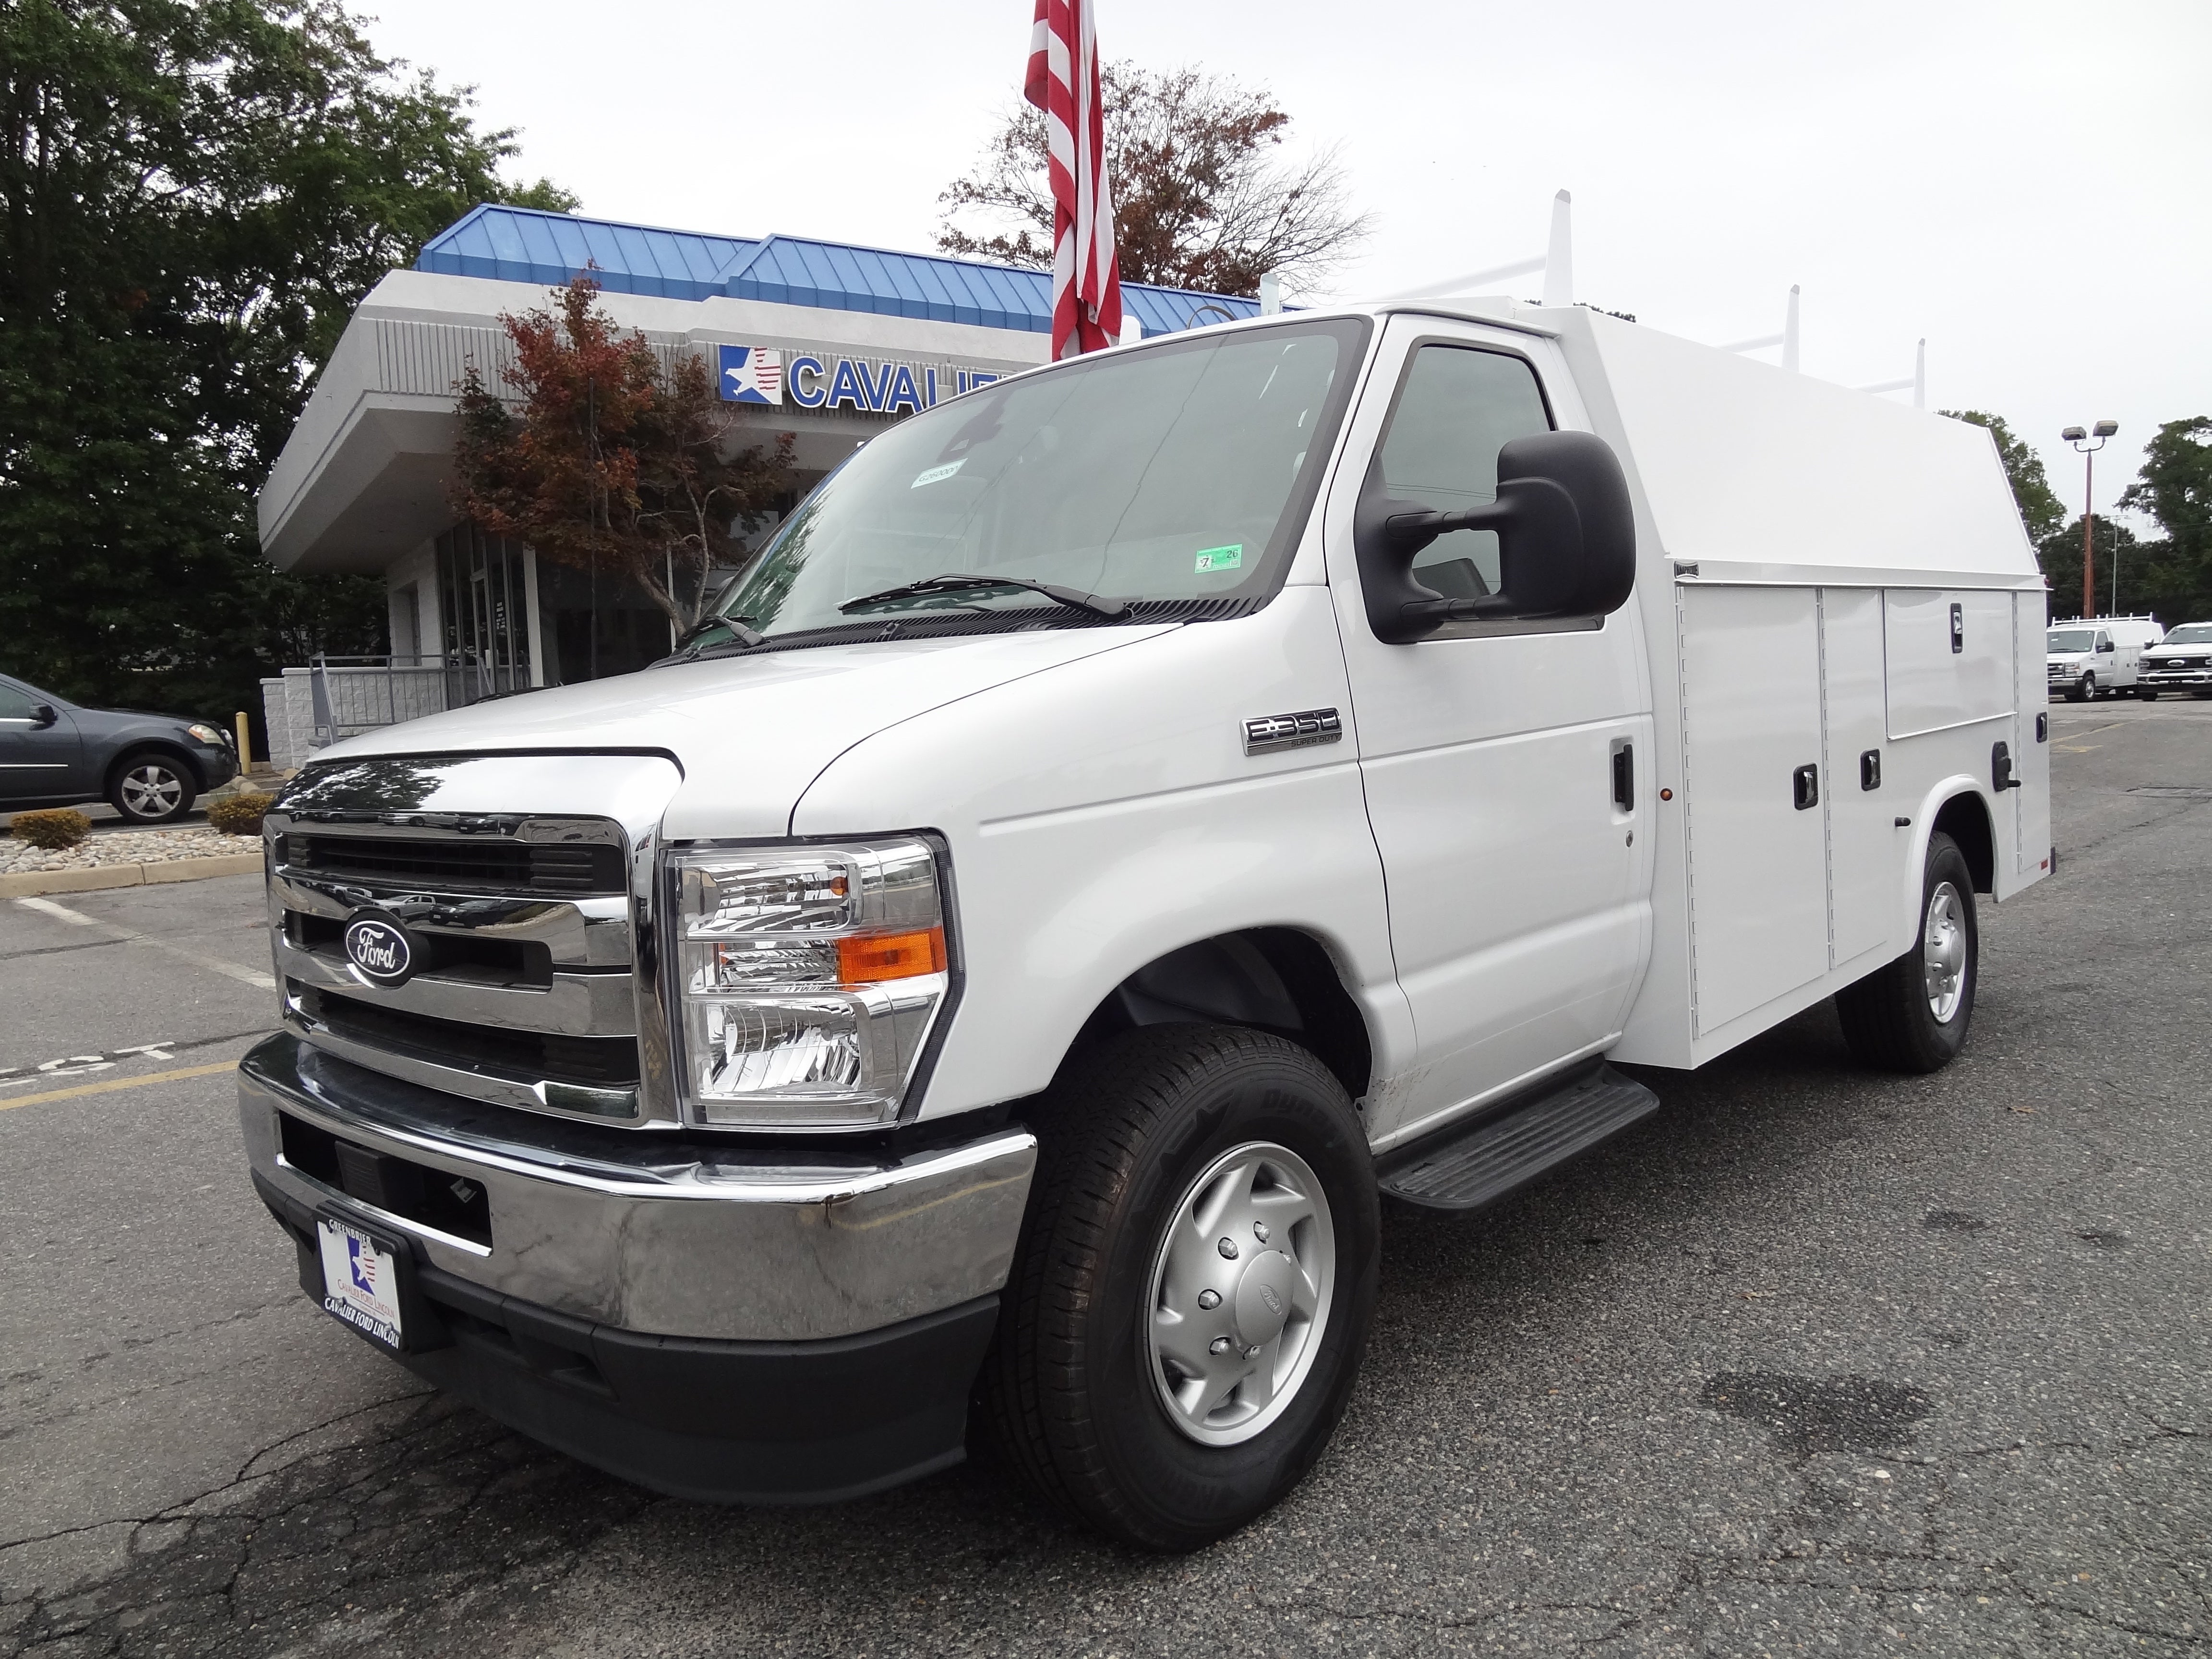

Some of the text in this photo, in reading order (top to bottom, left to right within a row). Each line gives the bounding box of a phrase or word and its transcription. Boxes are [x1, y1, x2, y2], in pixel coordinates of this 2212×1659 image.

[788, 356, 1016, 413] CAVAL
[1202, 557, 1210, 568] 7
[1226, 550, 1238, 558] 26
[1290, 734, 1339, 747] SUPER DUTY
[357, 927, 396, 969] Ford
[329, 1219, 372, 1247] GREENBRIER
[325, 1298, 355, 1322] CAVALIER
[355, 1311, 373, 1330] FORD
[373, 1322, 400, 1349] LINCOLN
